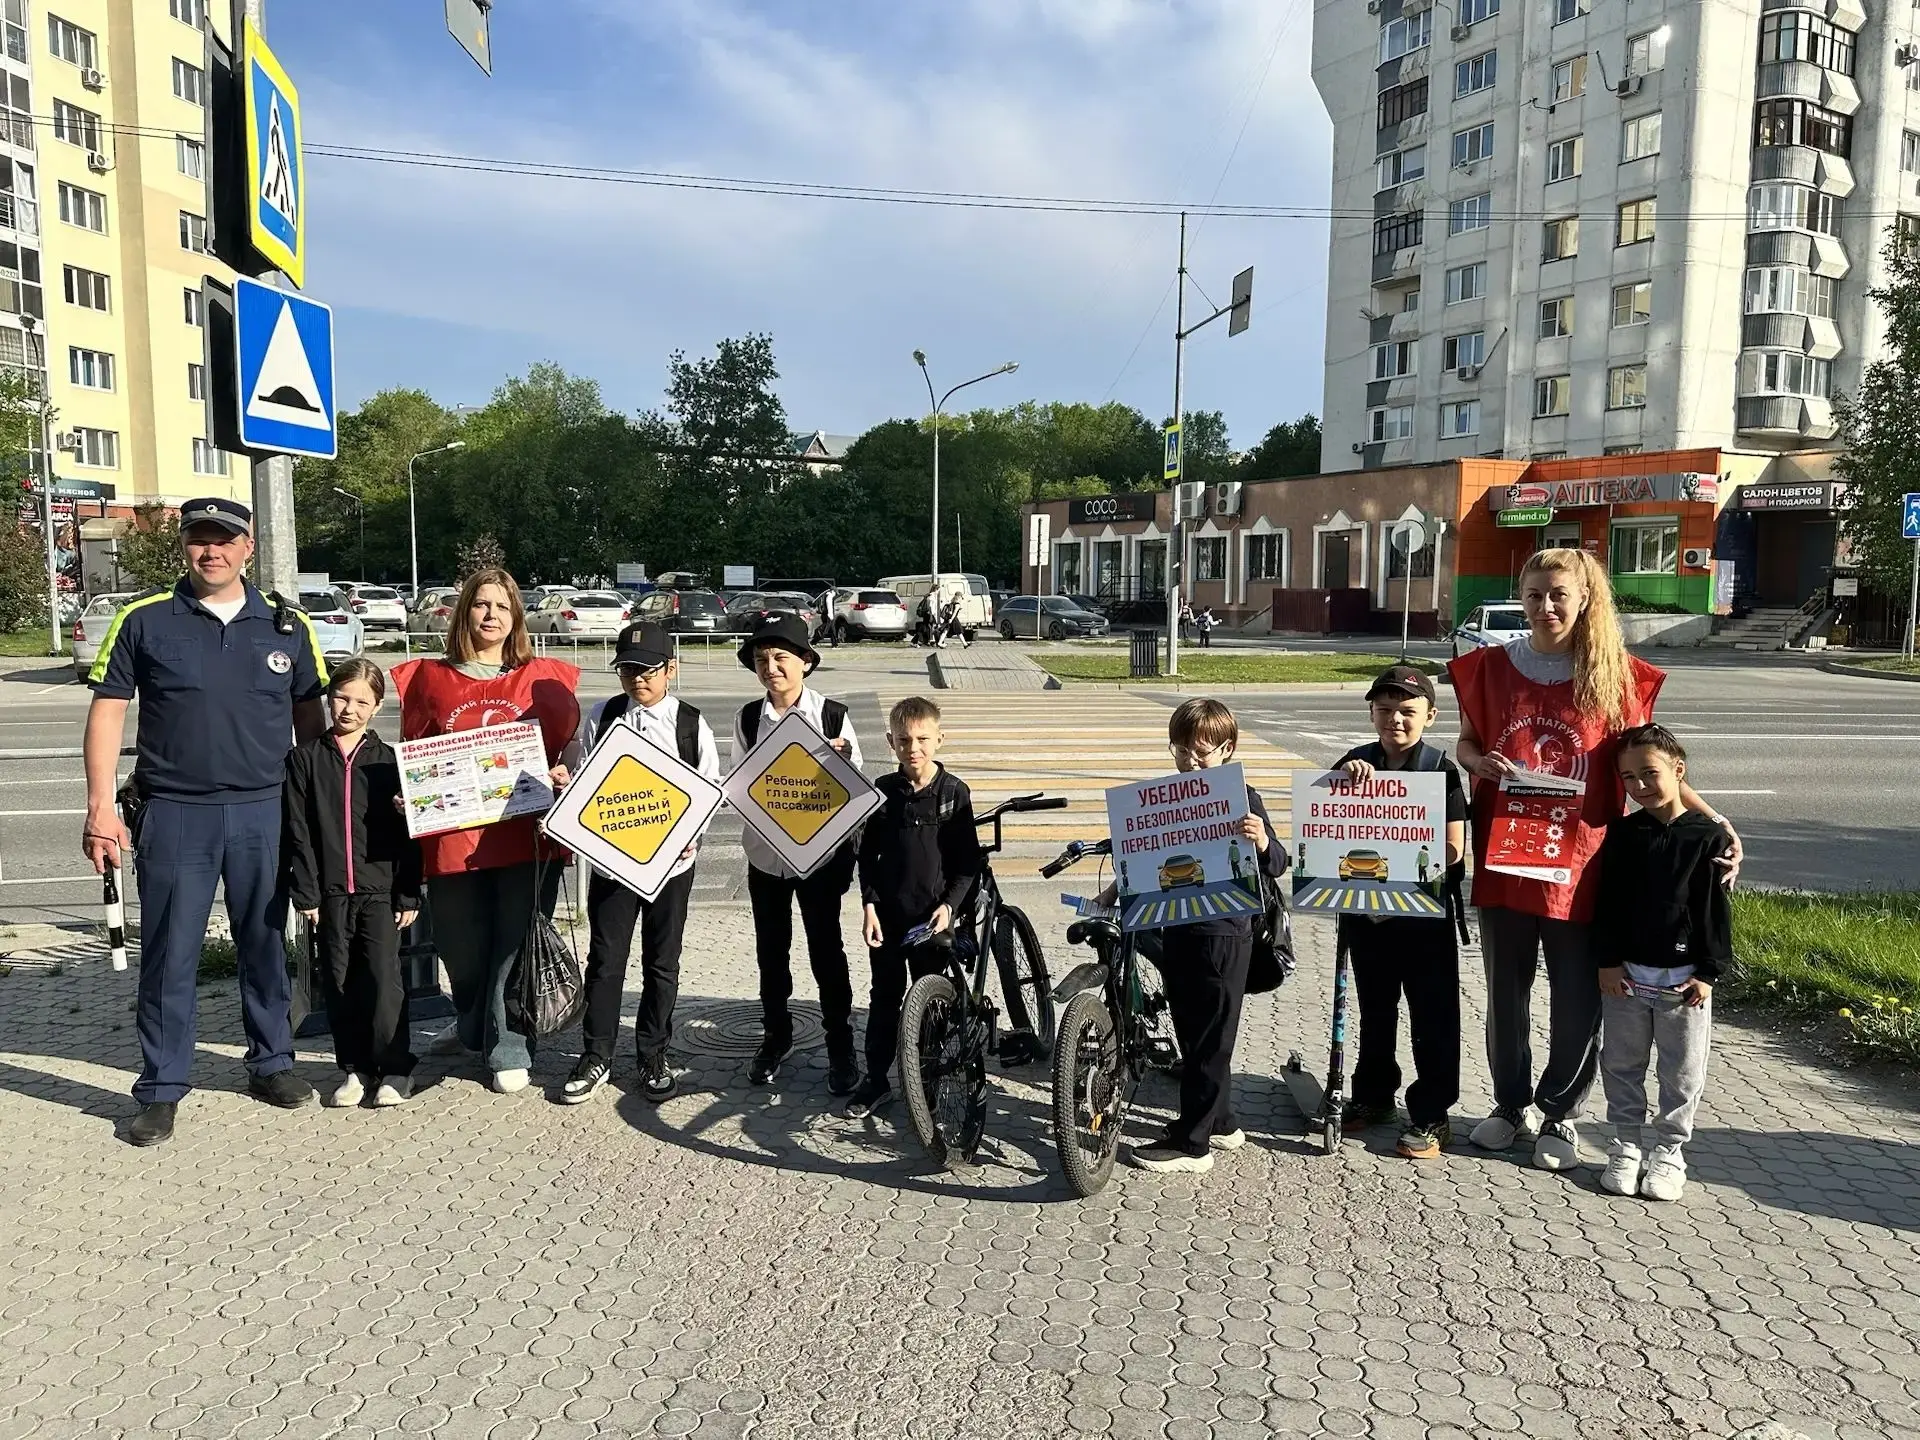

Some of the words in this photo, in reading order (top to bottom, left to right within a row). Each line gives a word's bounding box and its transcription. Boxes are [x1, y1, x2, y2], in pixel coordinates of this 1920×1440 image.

[1554, 477, 1656, 504] АПТЕКА
[1742, 488, 1779, 499] САЛОН
[1780, 486, 1823, 498] ЦВЕТОВ
[1776, 498, 1822, 507] ПОДАРКОВ
[1500, 511, 1548, 521] farmlend.ru
[446, 700, 478, 734] ЛЬСКИЙ
[480, 699, 523, 717] ПАТРУЛЬ
[401, 724, 536, 754] #БезопасныйПереход
[1495, 715, 1533, 754] ЛЬСКИЙ
[1536, 716, 1583, 748] ПАТРУЛЬ
[403, 743, 473, 761] #БезНаушников
[474, 732, 537, 749] #БезТелефона
[765, 774, 817, 787] Ребенок
[1329, 778, 1407, 799] УБЕДИСЬ
[596, 789, 655, 807] Ребенок
[766, 789, 831, 800] главный
[1138, 778, 1210, 808] УБЕДИСЬ
[1509, 788, 1573, 797] #ПаркуйСмартфон
[599, 797, 671, 820] главный
[767, 801, 831, 814] пассажир!
[1126, 817, 1134, 832] В
[1136, 800, 1231, 831] БЕЗОПАСНОСТИ
[1311, 803, 1319, 817] В
[1323, 803, 1426, 820] БЕЗОПАСНОСТИ
[601, 810, 672, 833] пассажир!
[1302, 824, 1345, 840] ПЕРЕД
[1349, 825, 1435, 842] ПЕРЕХОДОМ!
[1121, 834, 1160, 855] ПЕРЕД
